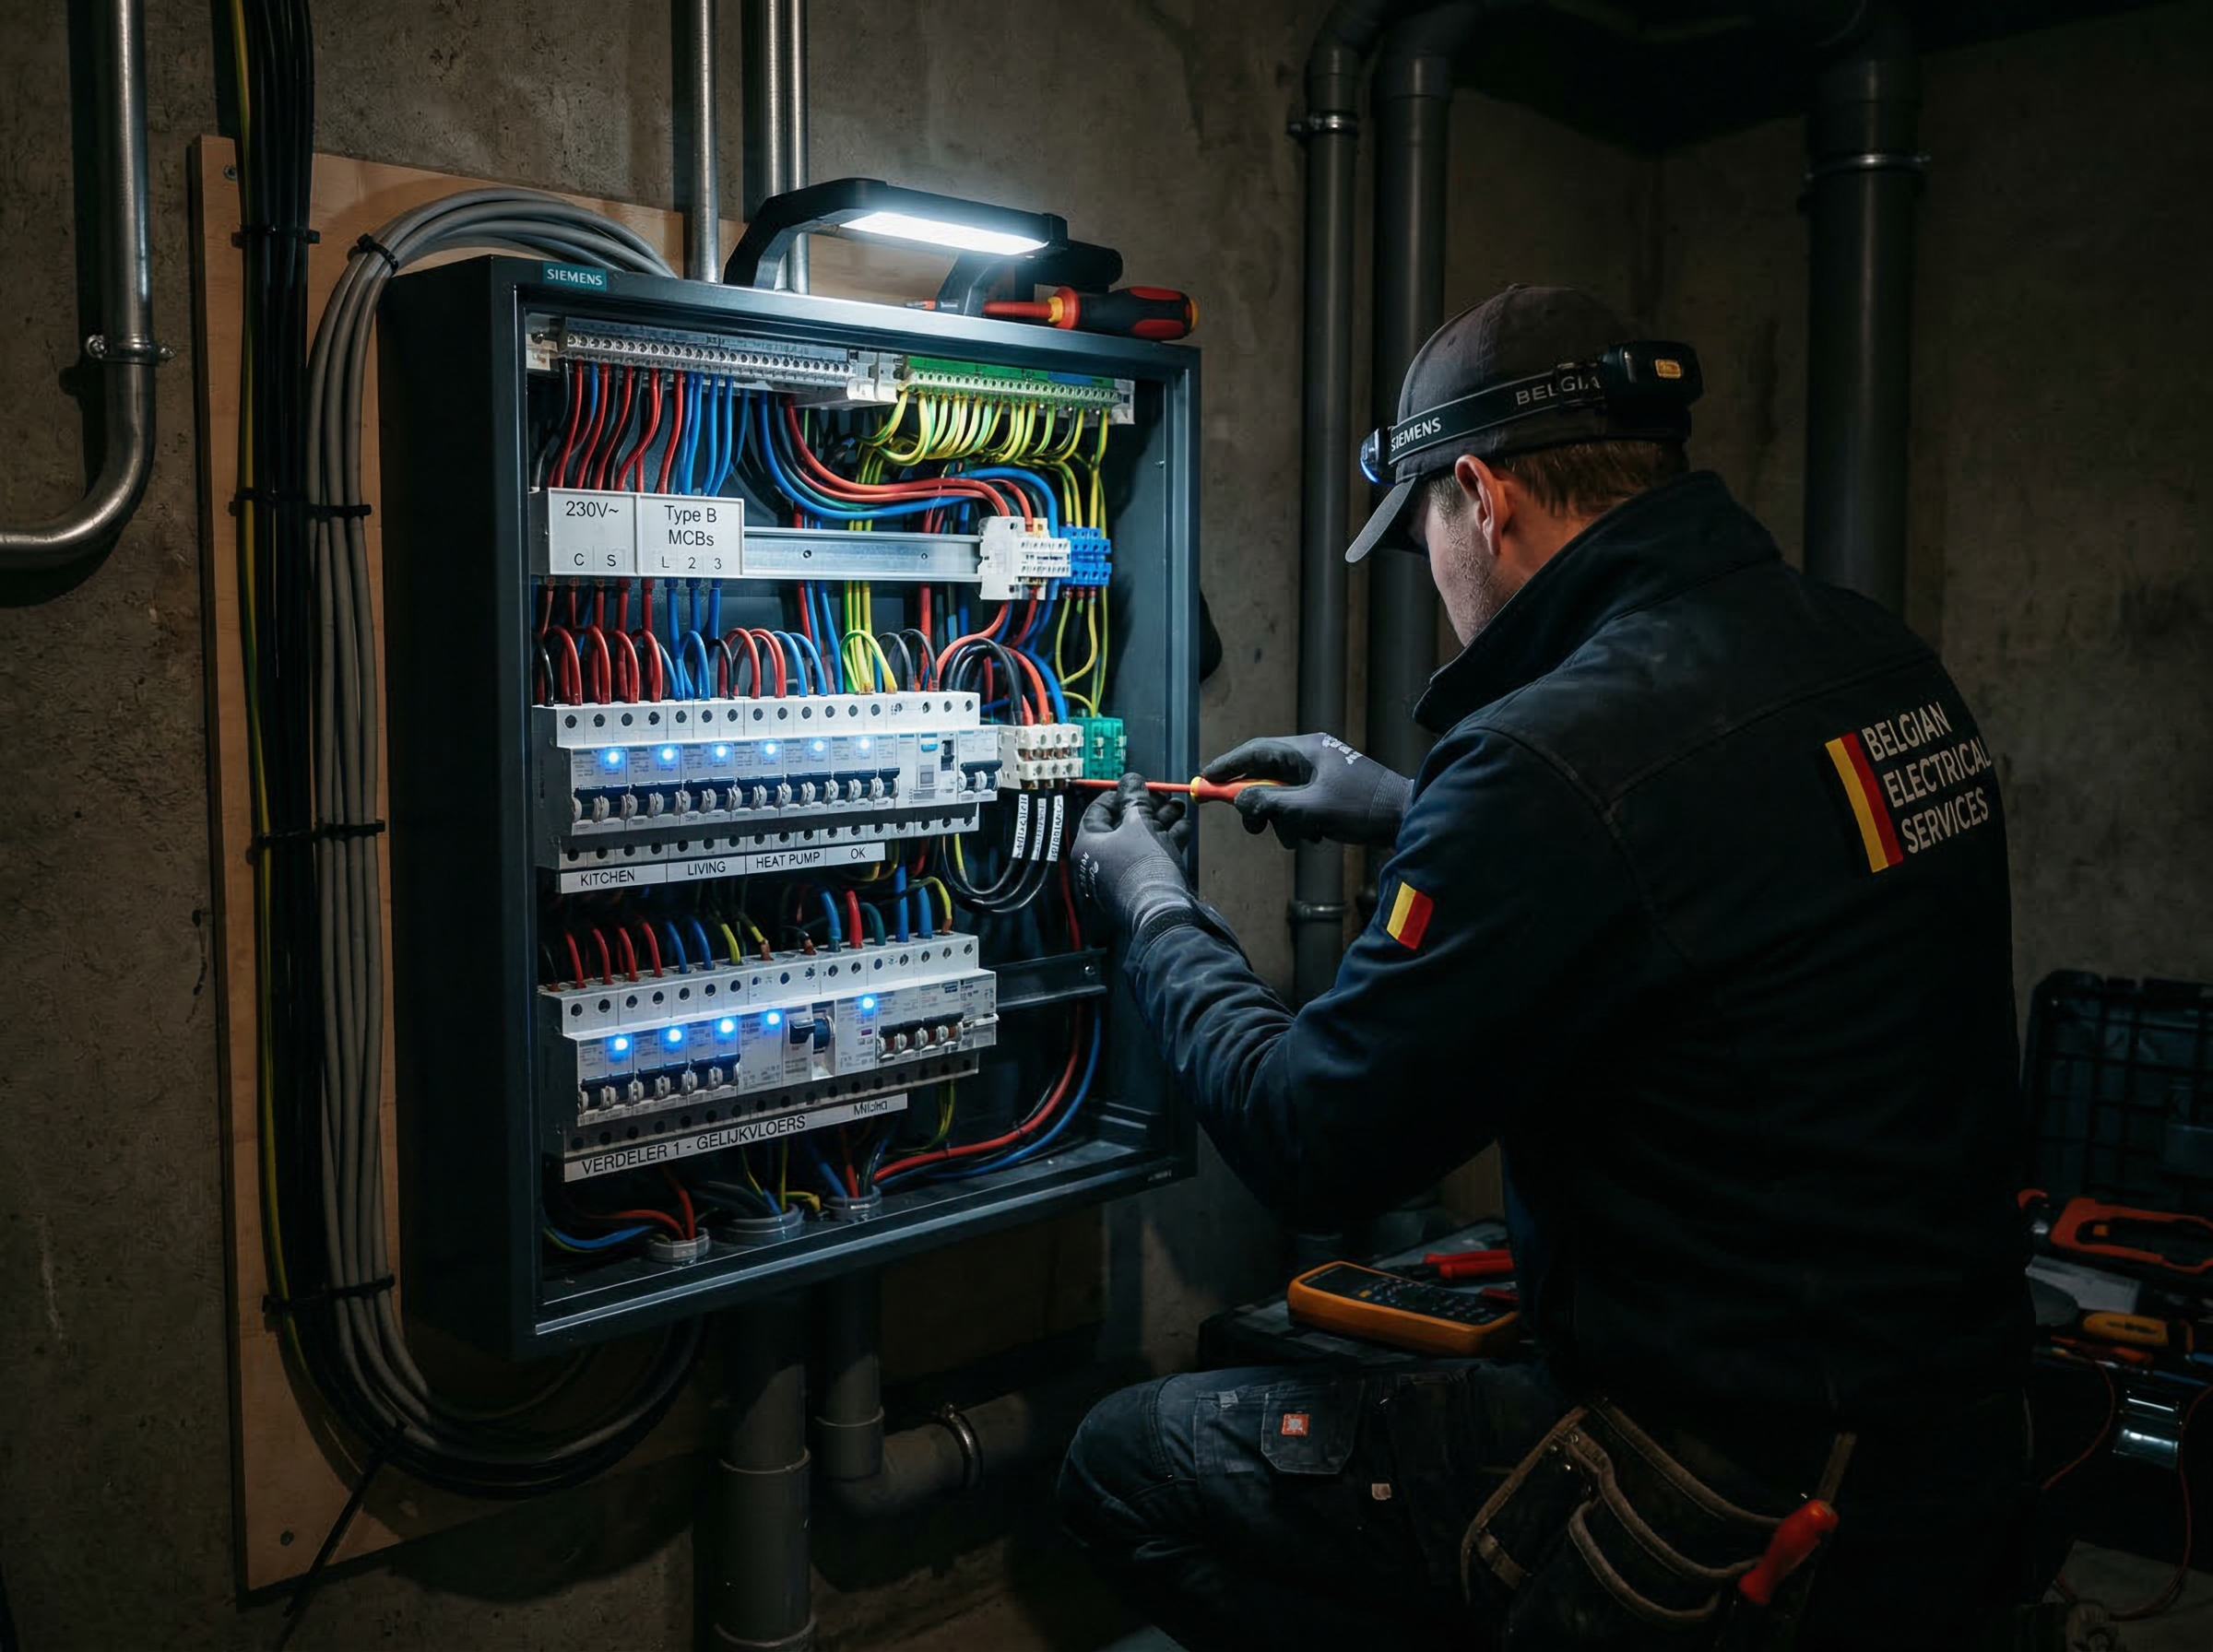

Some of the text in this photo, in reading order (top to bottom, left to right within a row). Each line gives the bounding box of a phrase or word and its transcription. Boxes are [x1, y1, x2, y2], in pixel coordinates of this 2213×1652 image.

[547, 268, 603, 286] SIEMENS
[1391, 417, 1441, 452] SIEMENS
[565, 500, 619, 518] 230V~
[664, 504, 717, 525] Type B
[669, 529, 715, 547] MCBs
[574, 553, 617, 567] C S
[661, 556, 722, 571] L 2 3
[1862, 702, 1953, 761] BELGIAN
[1883, 736, 1992, 808] ELECTRICAL
[1901, 786, 1989, 854] SERVICES
[756, 851, 821, 868] HEAT PUMP
[850, 847, 866, 859] OK
[580, 868, 635, 886] KITCHEN
[687, 861, 727, 876] LIVING
[582, 1144, 668, 1175] VERDELER
[674, 1142, 680, 1156] 1
[696, 1115, 806, 1150] GELIJKVLOERS
